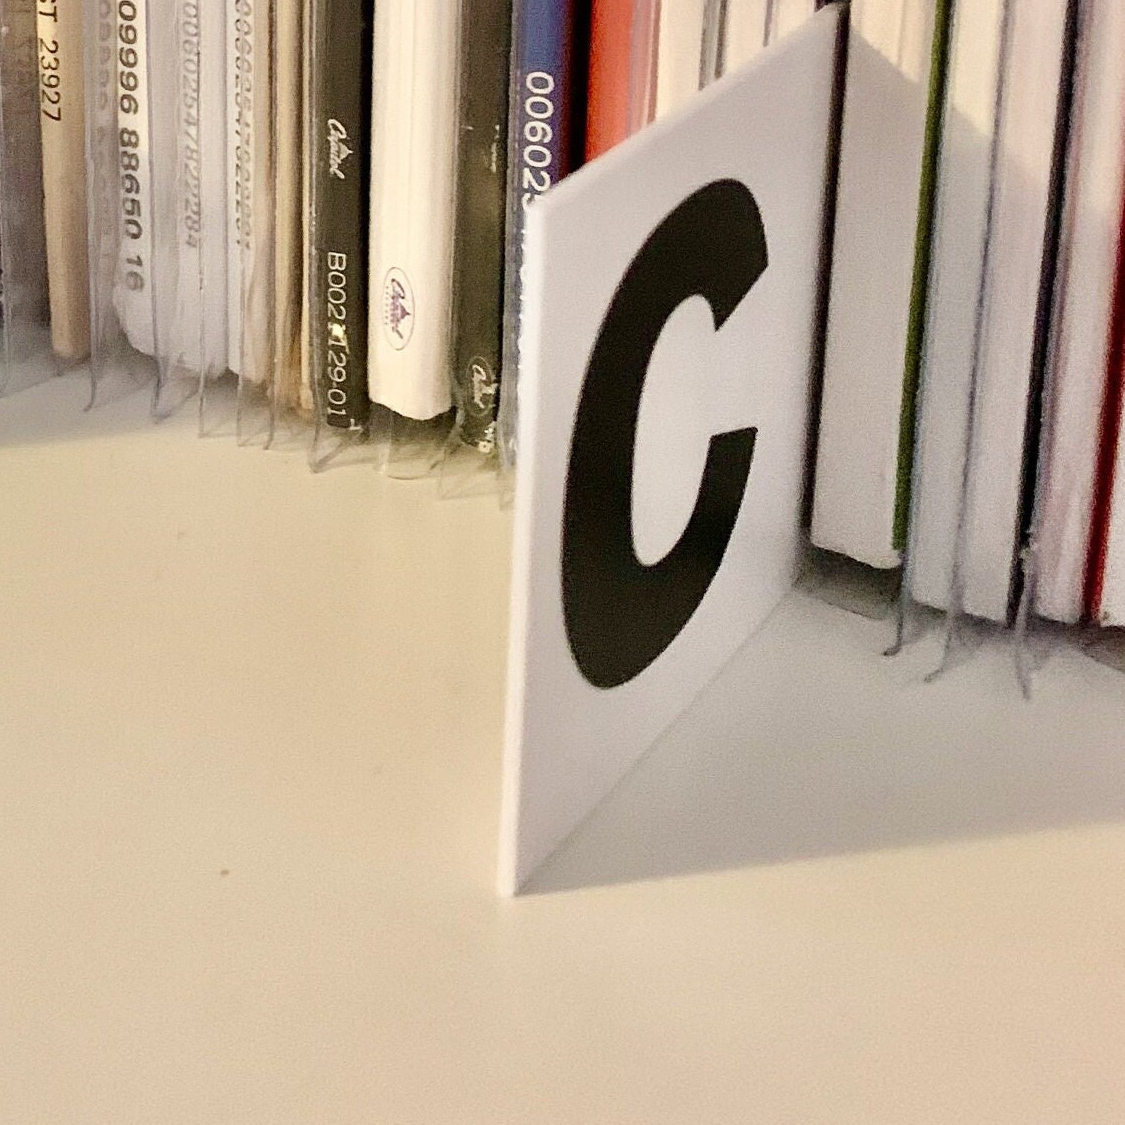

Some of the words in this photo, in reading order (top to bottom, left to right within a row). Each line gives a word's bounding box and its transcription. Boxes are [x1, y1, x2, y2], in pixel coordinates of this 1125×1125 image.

[38, 38, 62, 122] 23927
[119, 127, 144, 241] 88650
[327, 118, 353, 179] Capitol
[561, 178, 770, 690] C
